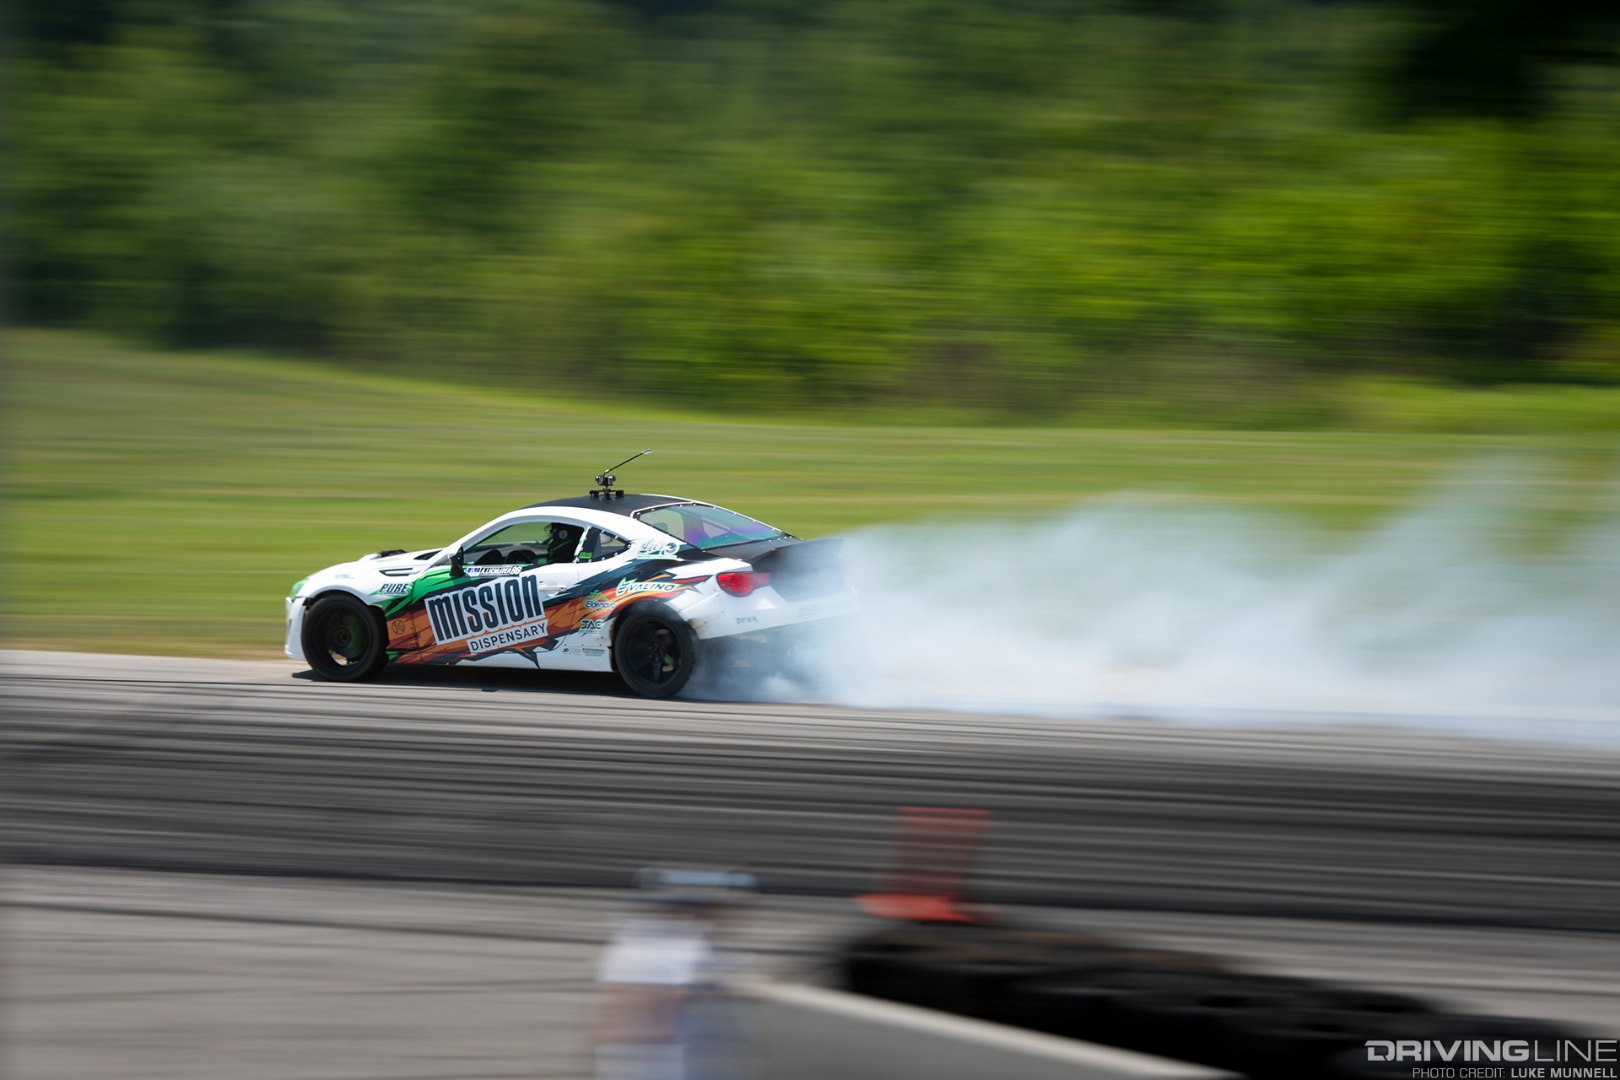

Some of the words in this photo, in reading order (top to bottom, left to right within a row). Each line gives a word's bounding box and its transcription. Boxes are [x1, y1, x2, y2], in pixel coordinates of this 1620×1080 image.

[379, 583, 409, 593] PURE
[629, 582, 675, 592] VALINO
[469, 622, 546, 652] DISPENSARY
